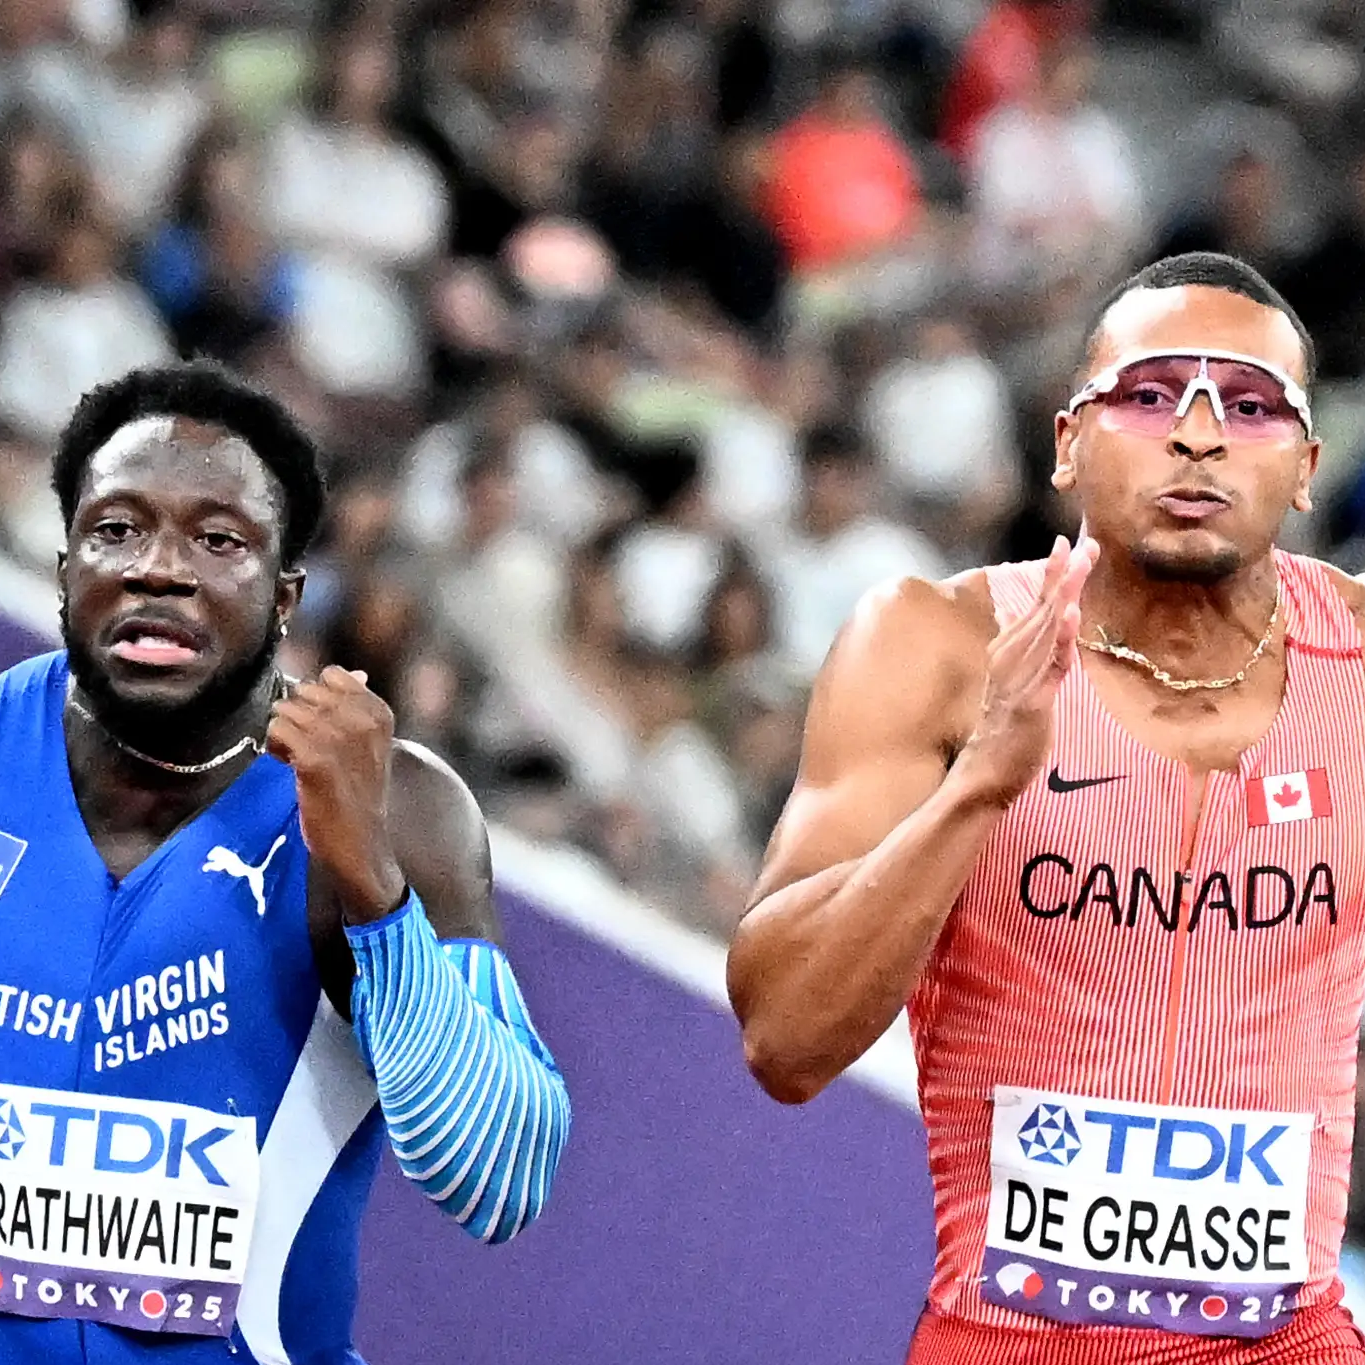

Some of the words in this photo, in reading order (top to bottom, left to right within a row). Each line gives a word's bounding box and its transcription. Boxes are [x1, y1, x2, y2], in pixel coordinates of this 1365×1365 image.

[1019, 852, 1338, 933] CANADA
[94, 949, 227, 1034] VIRGIN
[94, 1001, 230, 1072] ISLANDS
[29, 1102, 237, 1188] TDK
[1083, 1110, 1291, 1188] TDK
[1003, 1179, 1069, 1254] DE
[1082, 1194, 1292, 1273] GRASSE
